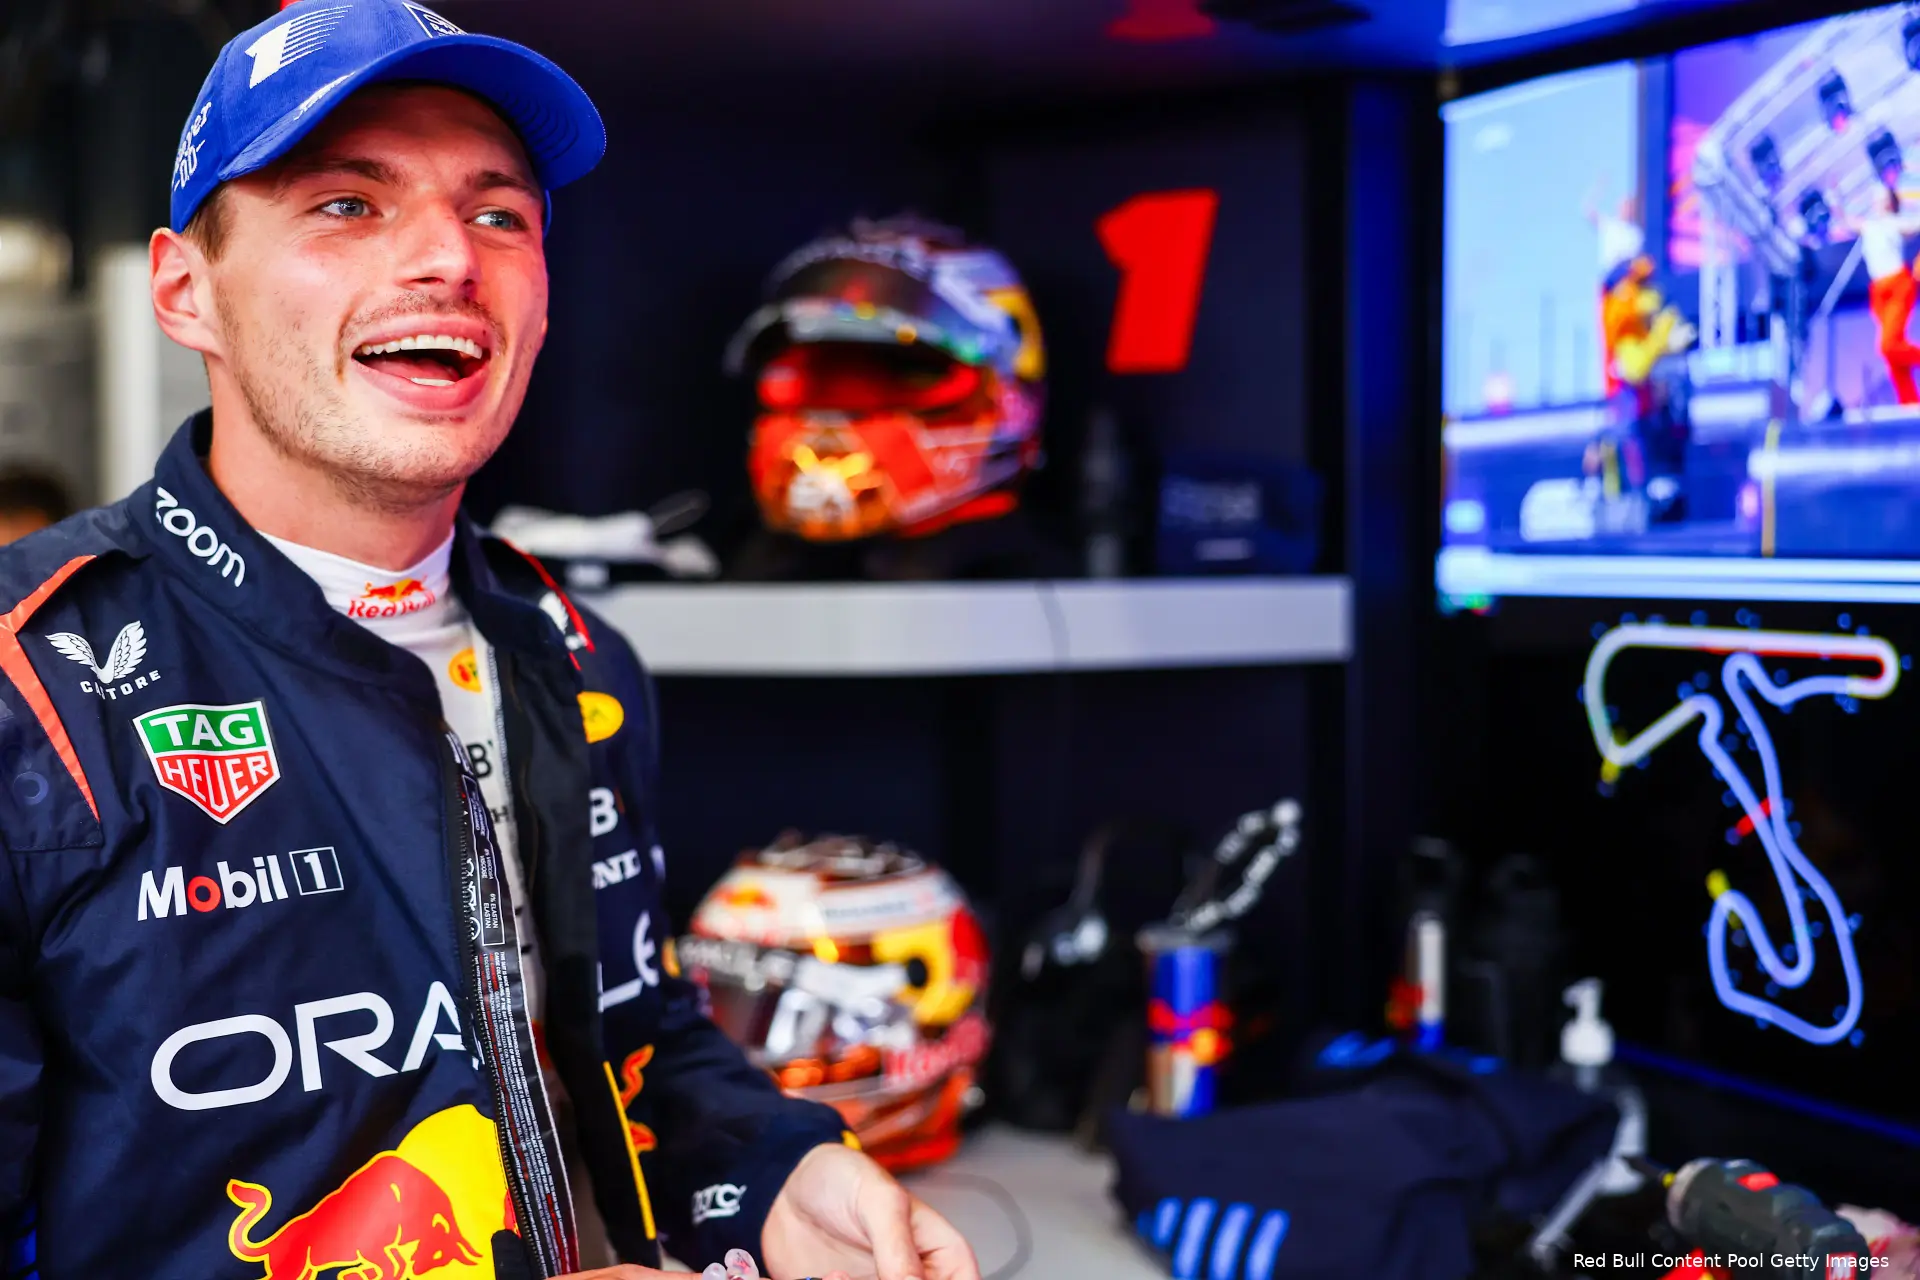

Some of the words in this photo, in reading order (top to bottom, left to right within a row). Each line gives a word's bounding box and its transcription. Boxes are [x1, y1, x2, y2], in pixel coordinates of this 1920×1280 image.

[244, 20, 293, 89] 1
[1095, 188, 1219, 373] 1
[156, 486, 246, 588] zoom
[347, 600, 397, 618] Red
[80, 669, 162, 701] CTORE
[150, 713, 257, 748] TAG
[162, 755, 270, 814] HEUER
[137, 854, 289, 921] Mobil
[151, 980, 485, 1111] ORA
